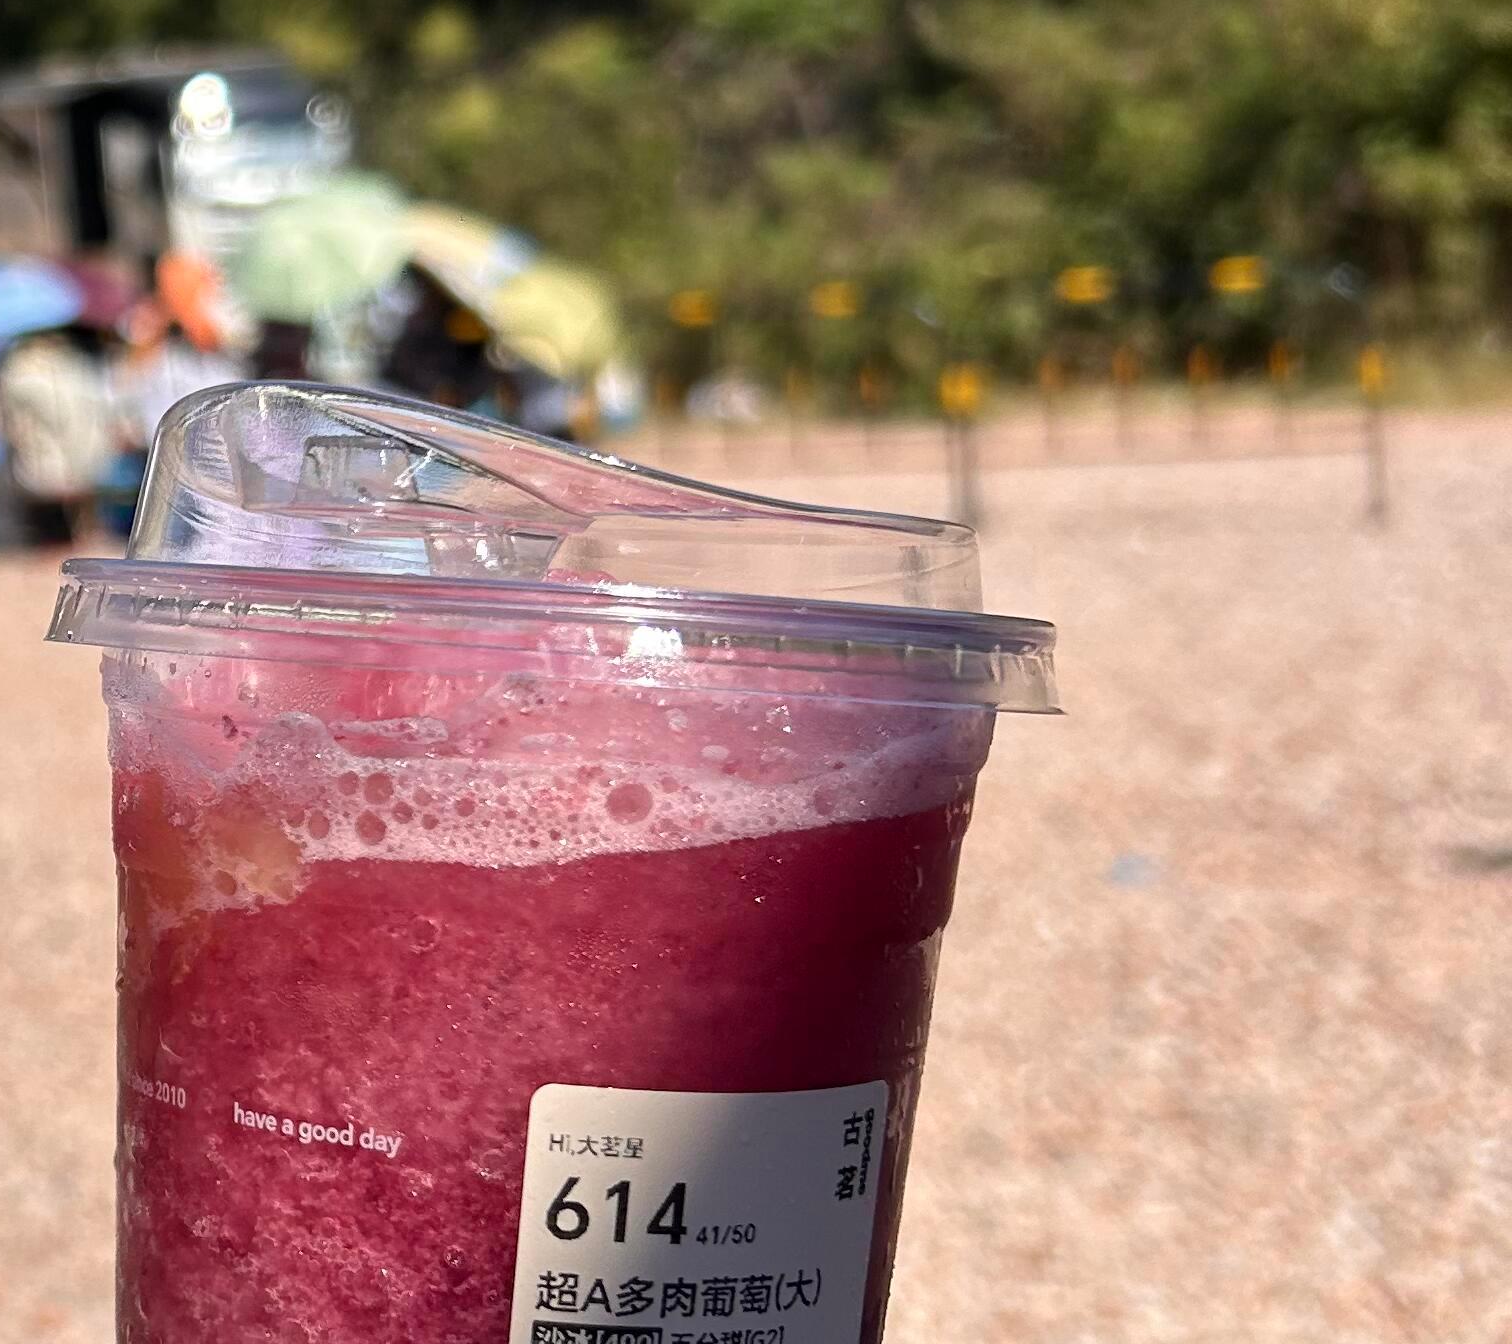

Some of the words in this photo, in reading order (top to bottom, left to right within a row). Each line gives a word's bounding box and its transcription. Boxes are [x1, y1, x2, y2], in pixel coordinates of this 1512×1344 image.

[155, 1080, 186, 1109] 2010
[234, 1102, 278, 1133] have
[282, 1117, 294, 1136] a
[298, 1121, 354, 1147] good
[359, 1128, 402, 1159] day
[545, 1176, 687, 1245] 614
[696, 1223, 756, 1245] 41/50
[534, 1269, 822, 1318] 超A多肉葡萄(大)
